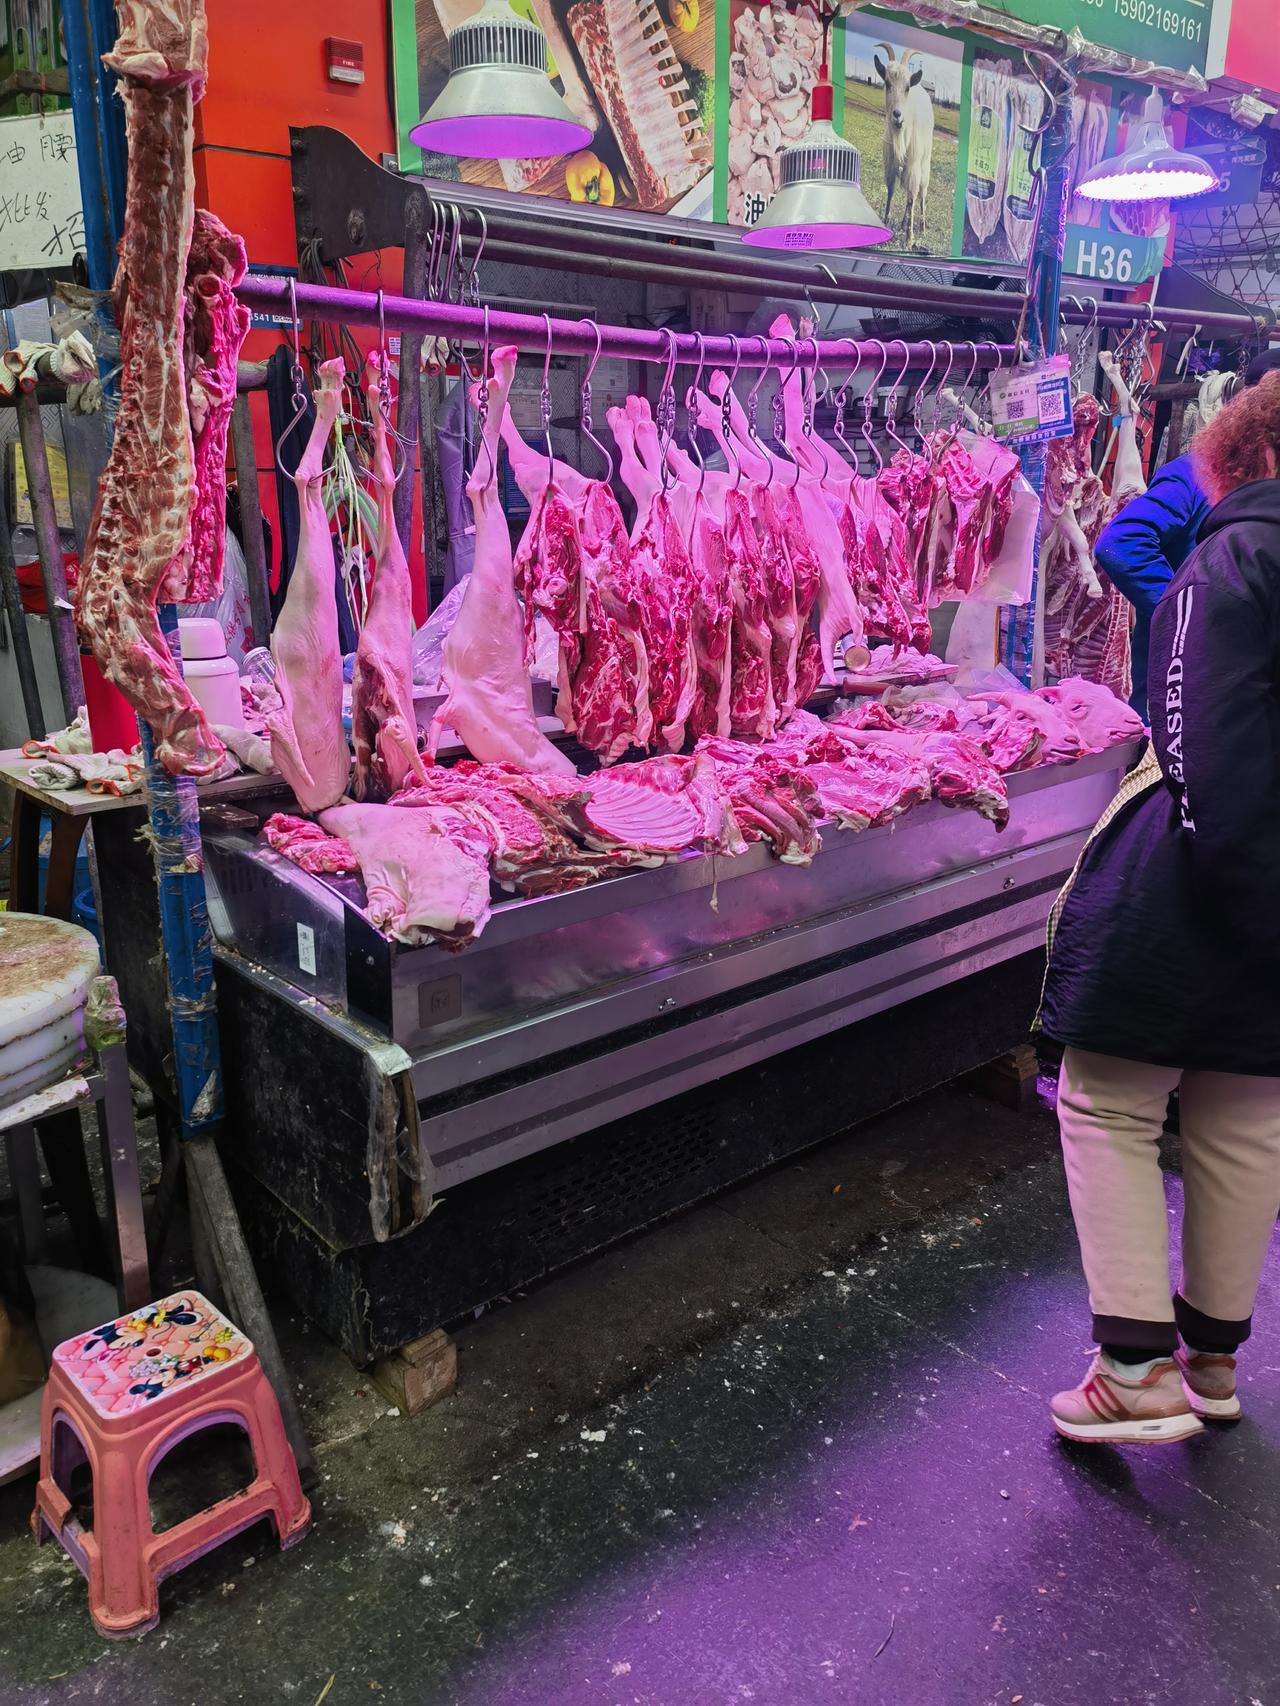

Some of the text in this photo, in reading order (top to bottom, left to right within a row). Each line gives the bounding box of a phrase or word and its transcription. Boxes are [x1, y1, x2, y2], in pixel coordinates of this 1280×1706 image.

[1113, 0, 1202, 43] 15902169161
[342, 59, 355, 67] FIRE
[1076, 239, 1133, 283] H36
